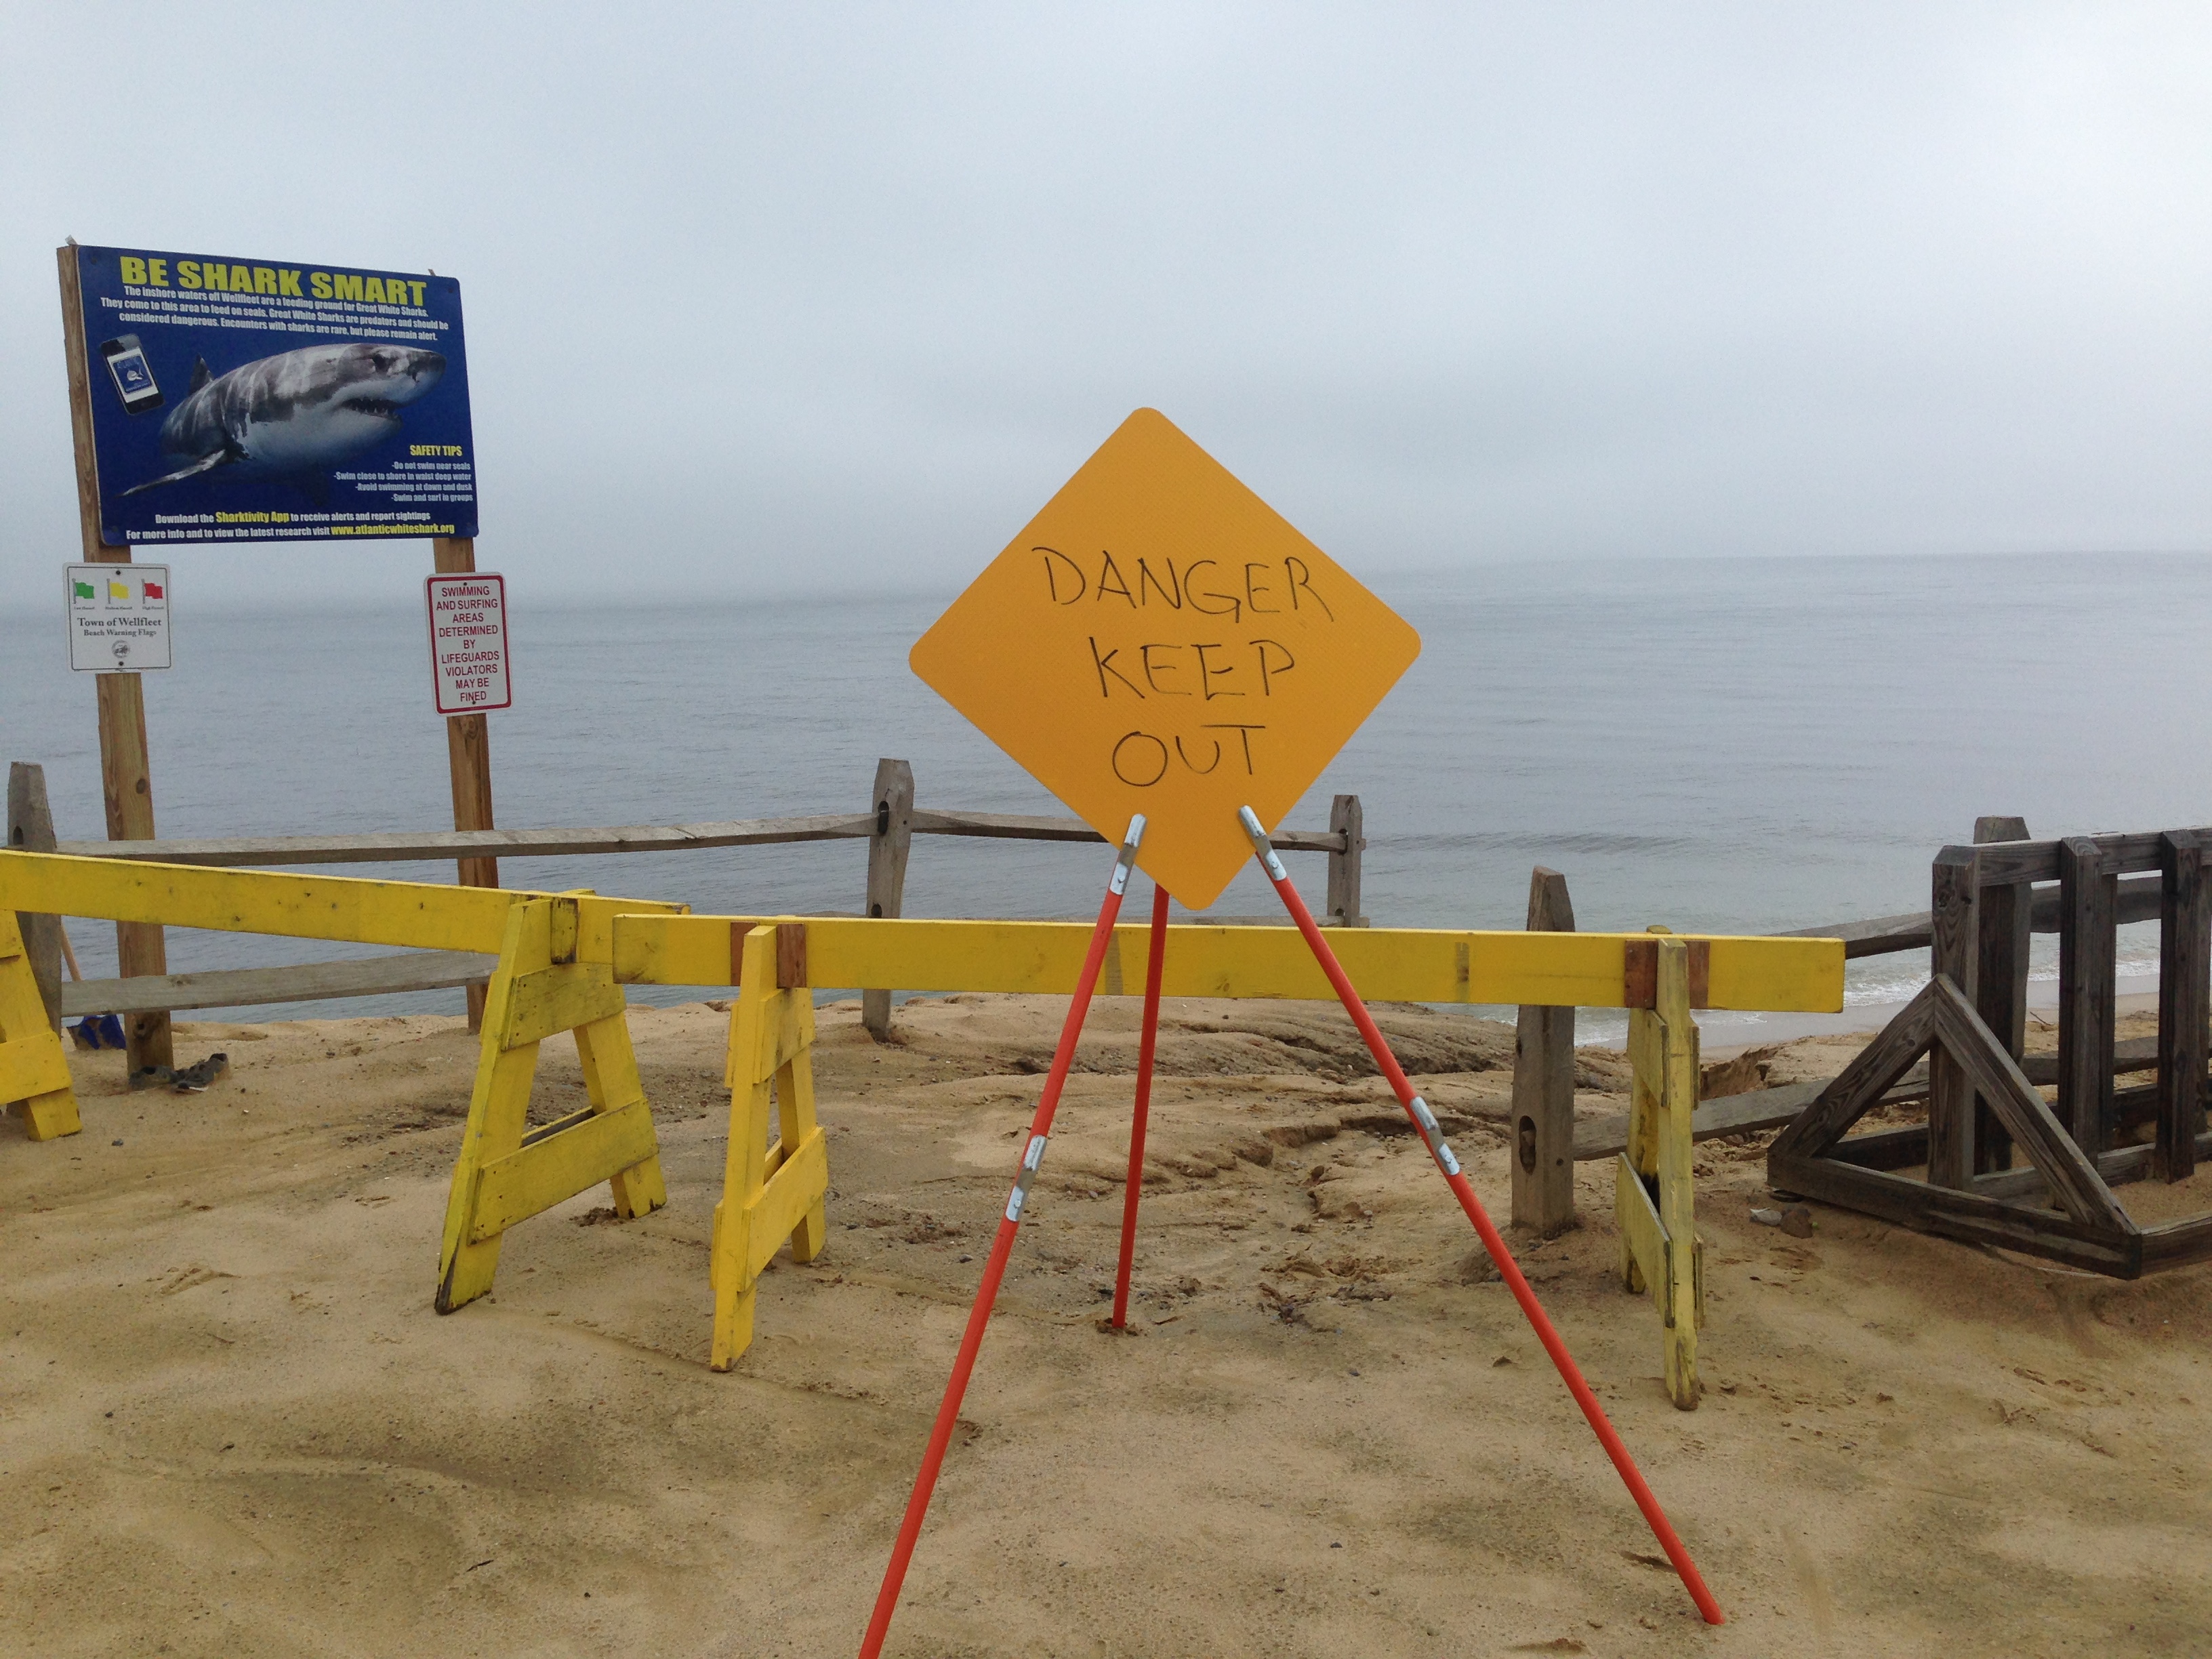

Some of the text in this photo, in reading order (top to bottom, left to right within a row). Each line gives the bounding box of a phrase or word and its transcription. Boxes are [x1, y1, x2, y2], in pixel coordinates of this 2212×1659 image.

[120, 255, 427, 306] BE SHARK SMART
[124, 285, 141, 296] The
[142, 287, 176, 298] inshore
[178, 290, 207, 301] waters
[209, 292, 220, 302] off
[221, 292, 260, 304] Wellfleet
[261, 297, 275, 306] are
[283, 297, 314, 310] feeding
[315, 300, 343, 311] ground
[344, 302, 355, 312] for
[356, 302, 377, 313] Great
[377, 304, 400, 315] White
[100, 297, 123, 309] They
[124, 300, 149, 309] come
[151, 301, 160, 310] to
[161, 302, 179, 312] this
[180, 304, 200, 312] area
[201, 304, 209, 313] to
[211, 304, 230, 314] feed
[231, 307, 243, 315] on
[269, 309, 291, 319] Great
[292, 310, 316, 321] White
[317, 312, 344, 323] Sharks
[346, 314, 359, 323] are
[360, 315, 397, 326] predators
[398, 318, 412, 327] and
[413, 319, 438, 329] should
[439, 321, 449, 330] be
[119, 312, 169, 323] considered
[171, 314, 220, 327] dangerous.
[221, 318, 268, 330] Encounters
[268, 321, 286, 331] with
[287, 322, 315, 333] sharks
[316, 325, 329, 333] are
[350, 327, 363, 335] but
[364, 328, 389, 337] please
[390, 329, 417, 339] remain
[418, 331, 438, 341] alert.
[409, 445, 463, 457] SAFETY TIPS
[434, 473, 451, 481] deep
[379, 483, 414, 491] swimming
[155, 511, 430, 524] Download the Sharktivity App to receive alerts and report sightings
[126, 523, 455, 539] For more info and to view the latest research visit www.atlanticwhiteshark.org
[1031, 546, 1334, 624] DANGER
[442, 586, 490, 597] SWIMMING
[436, 598, 497, 611] AND SURFING
[77, 617, 161, 626] Town of Wellfleet
[453, 613, 484, 623] AREAS
[106, 629, 136, 637] Warning
[138, 629, 157, 637] Flags
[439, 625, 498, 637] DETERMINED
[464, 639, 476, 649] BY
[441, 651, 499, 664] LIFEGUARDS
[445, 664, 497, 676] VIOLATORS
[1088, 635, 1295, 701] KEEP
[455, 678, 489, 689] MAY BE
[460, 691, 487, 702] FINED
[1111, 724, 1267, 787] OUT
